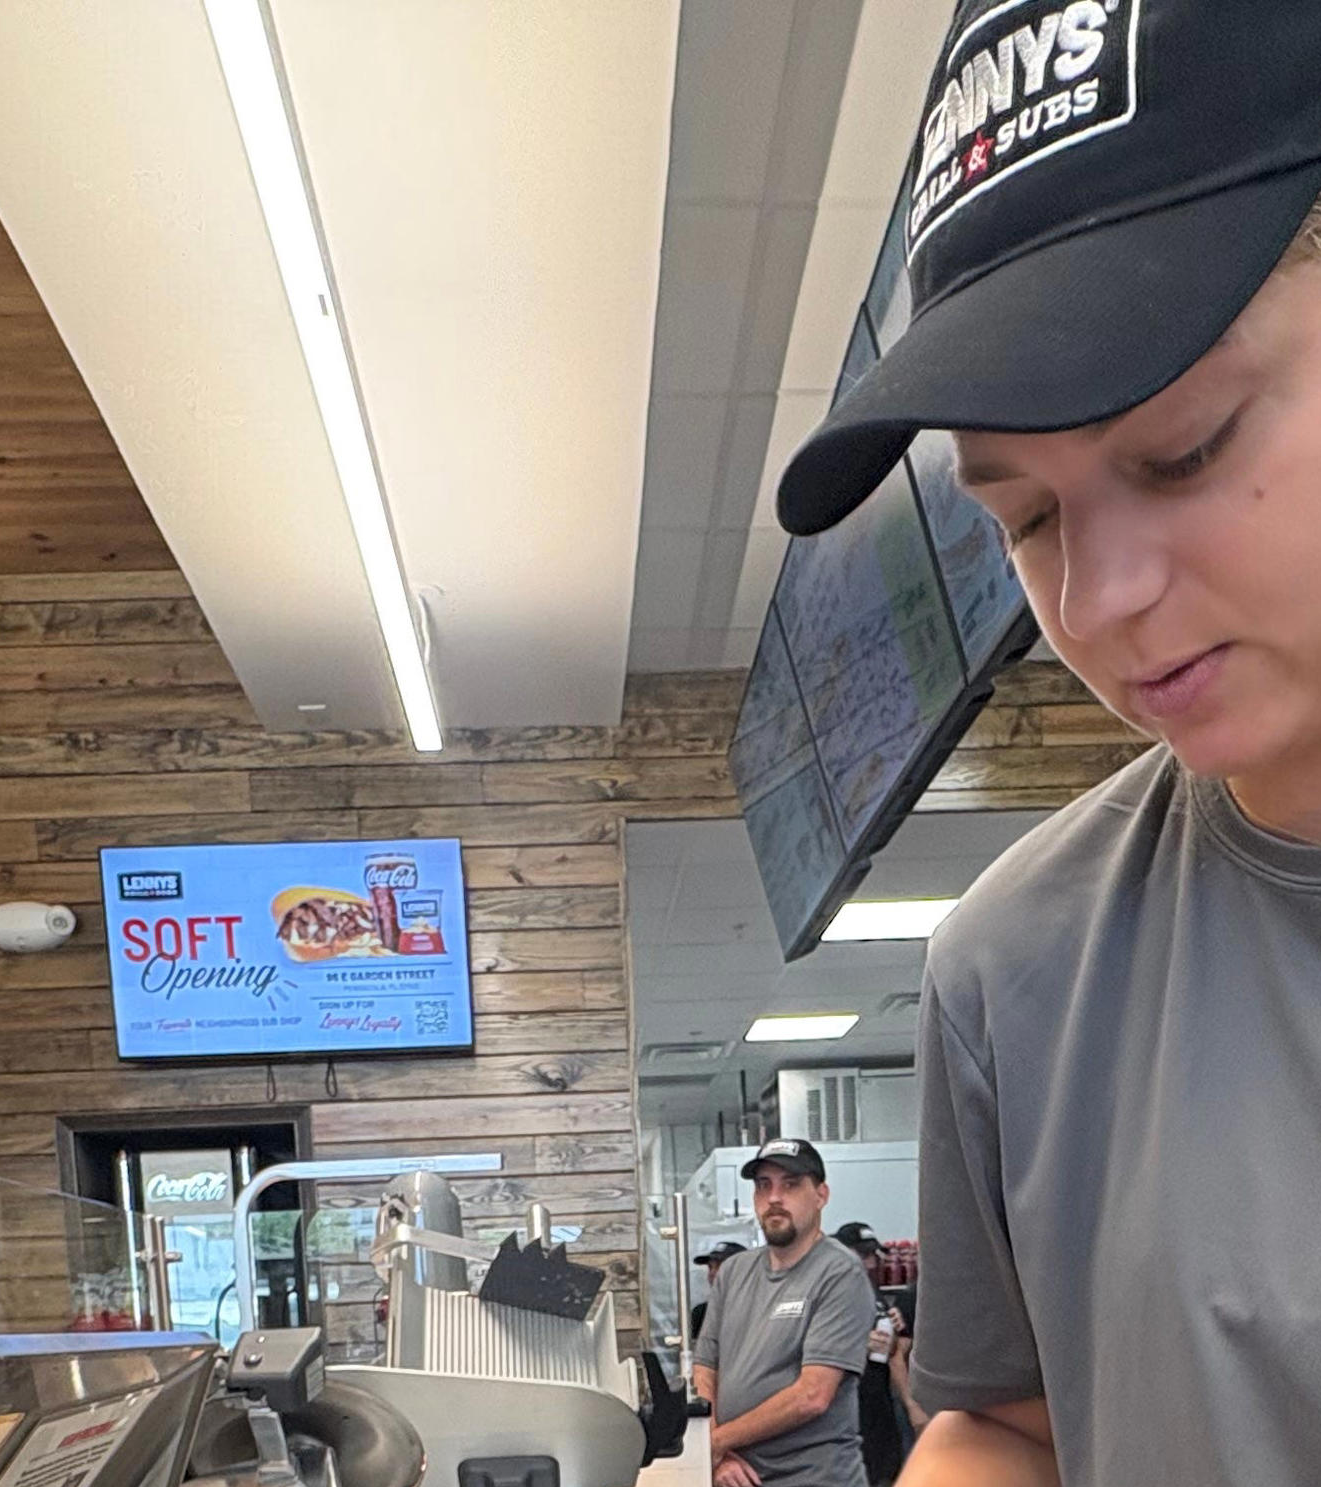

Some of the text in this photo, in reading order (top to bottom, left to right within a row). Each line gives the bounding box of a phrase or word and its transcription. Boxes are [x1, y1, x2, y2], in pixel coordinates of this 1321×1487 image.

[995, 77, 1099, 155] SUBS
[122, 916, 243, 963] SOFT
[141, 952, 278, 1000] Opening
[350, 970, 393, 981] GARDEN
[396, 969, 435, 980] STREET
